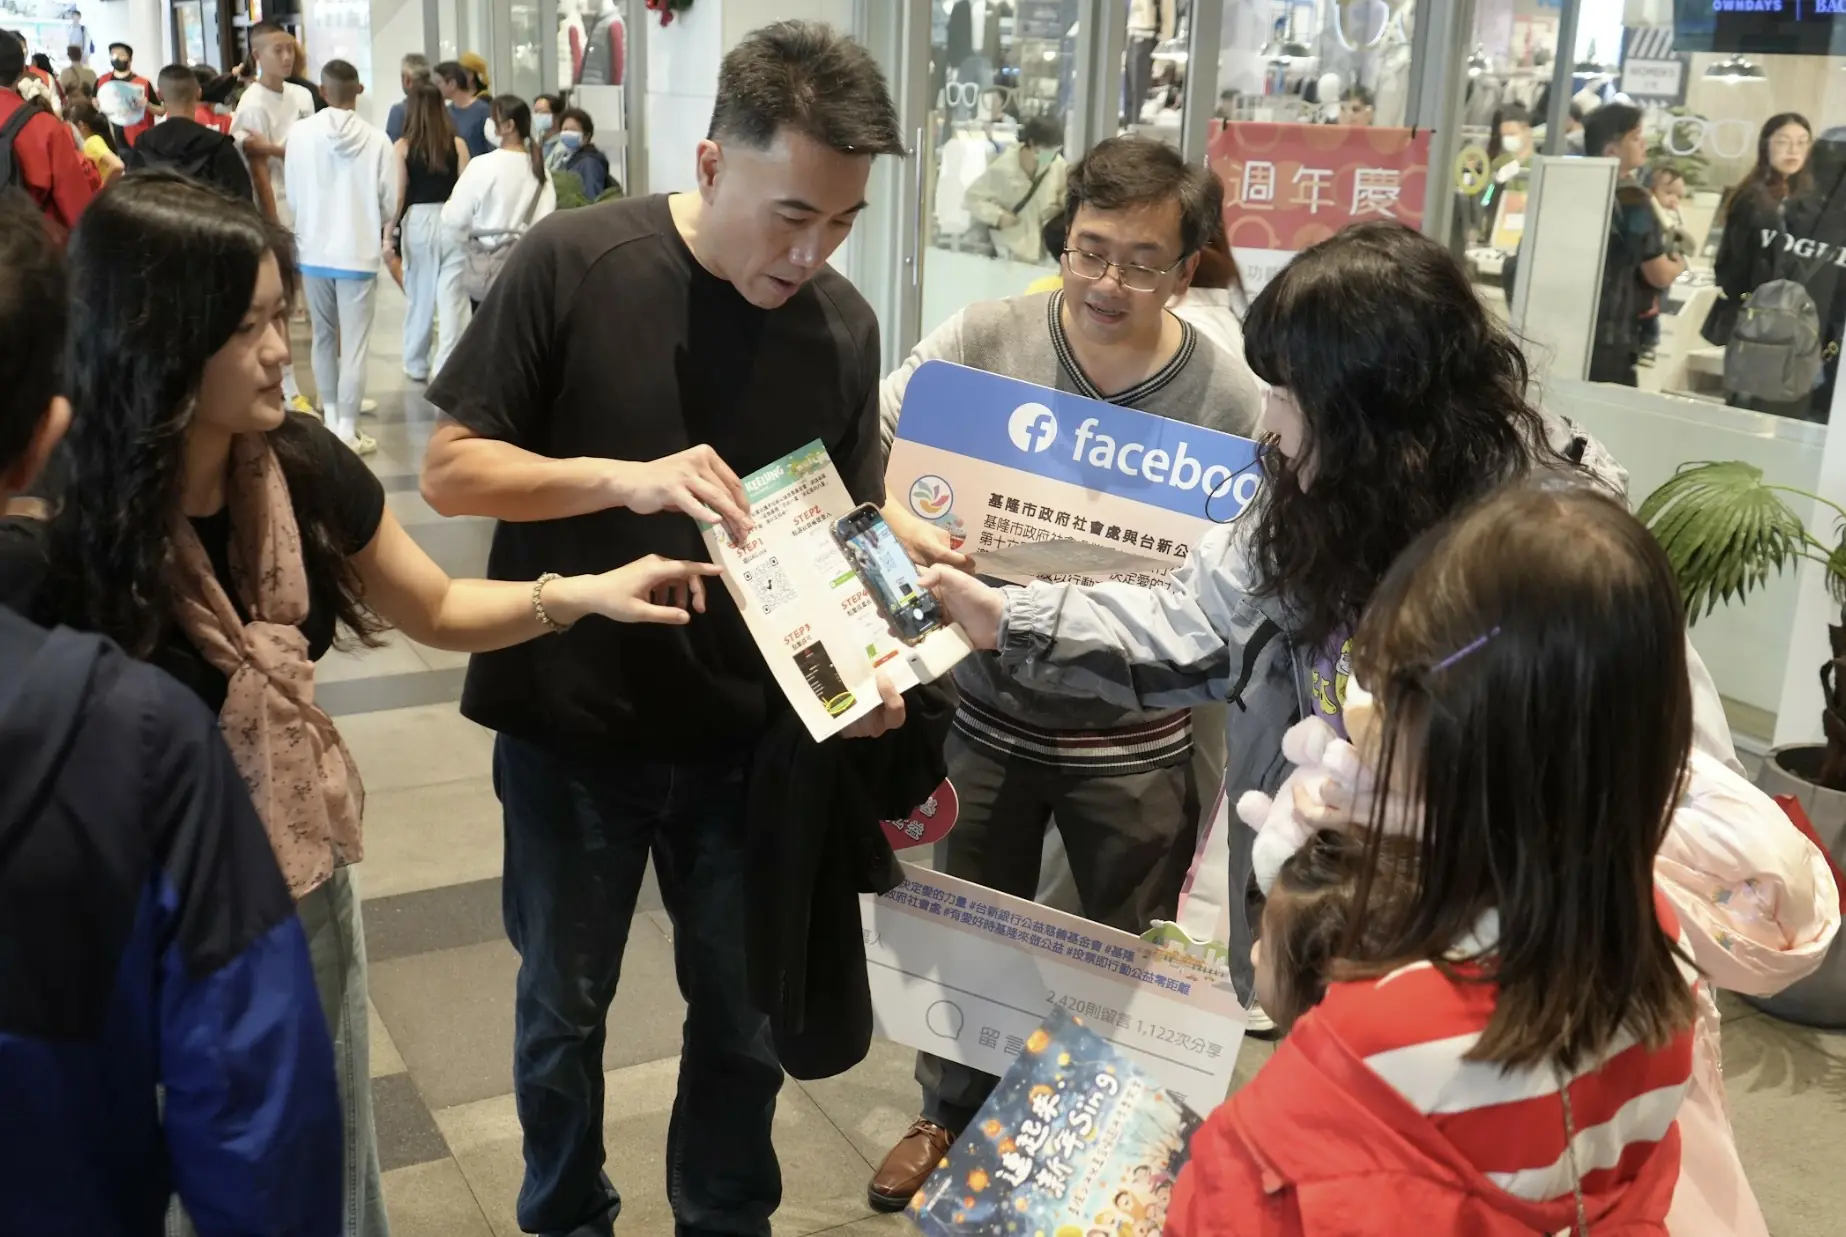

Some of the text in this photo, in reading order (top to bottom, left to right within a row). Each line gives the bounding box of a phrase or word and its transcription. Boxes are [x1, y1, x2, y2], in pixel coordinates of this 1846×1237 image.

[1227, 160, 1402, 218] 週年慶
[1137, 1019, 1225, 1059] 1,122次分享
